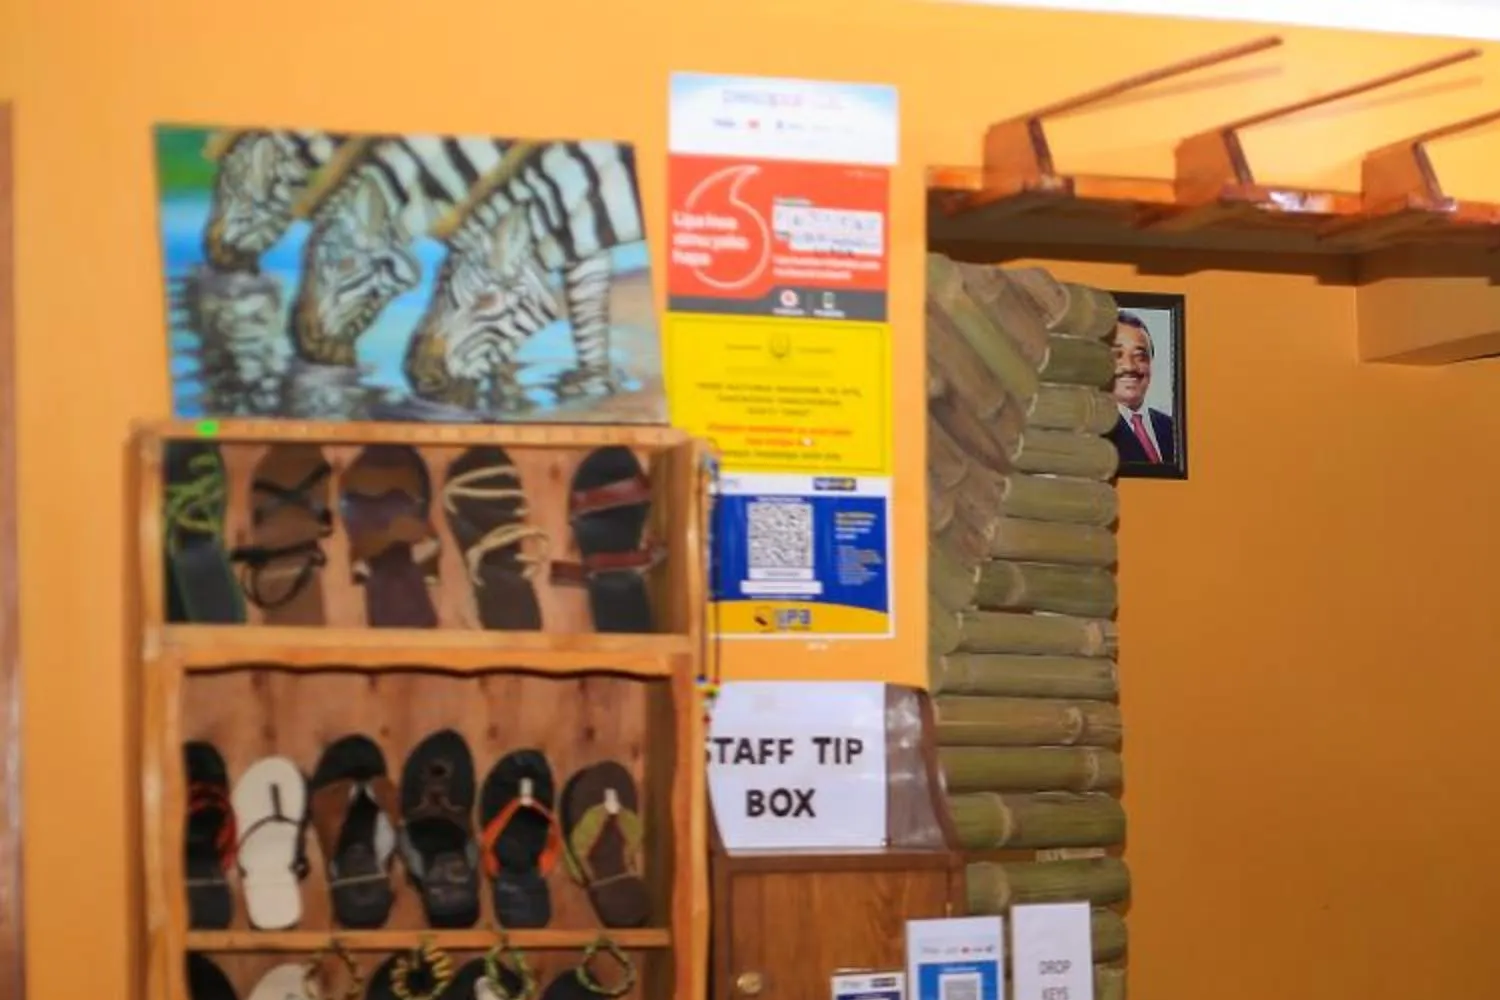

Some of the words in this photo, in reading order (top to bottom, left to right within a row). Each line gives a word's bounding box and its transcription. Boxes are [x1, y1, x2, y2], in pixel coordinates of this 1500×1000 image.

[812, 737, 863, 765] TIP
[746, 788, 816, 818] BOX
[1039, 959, 1072, 975] DROP
